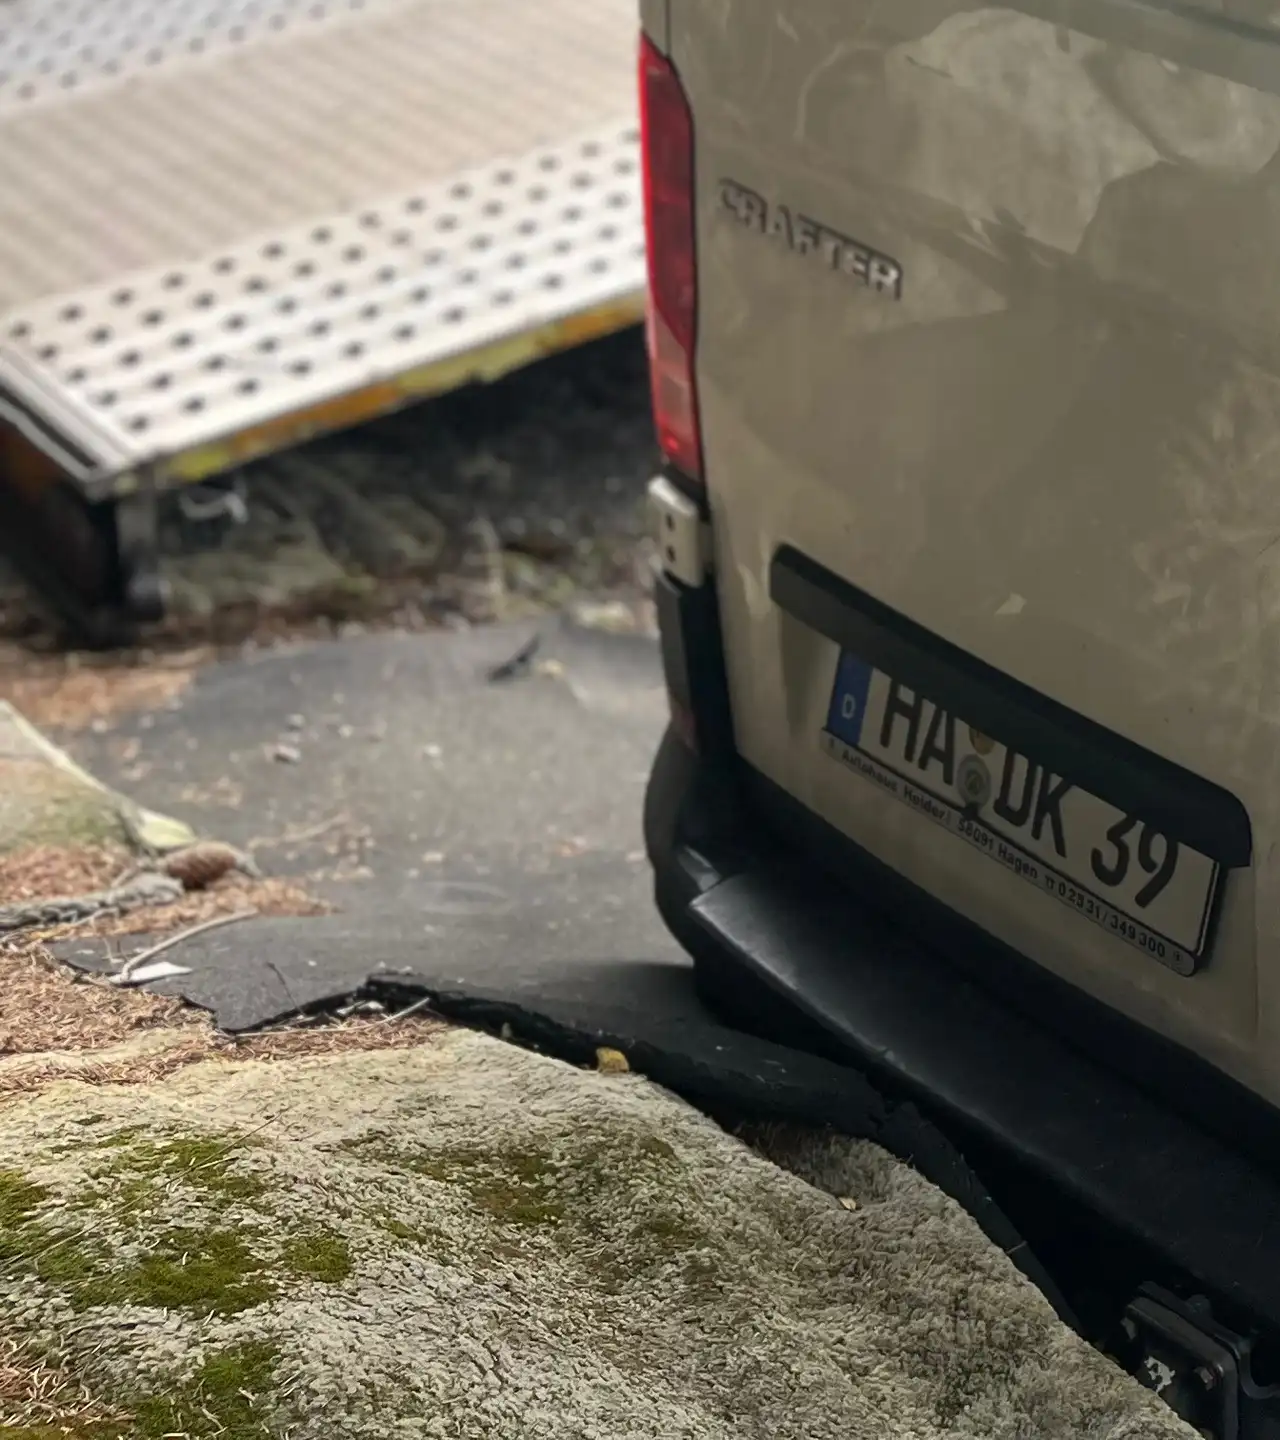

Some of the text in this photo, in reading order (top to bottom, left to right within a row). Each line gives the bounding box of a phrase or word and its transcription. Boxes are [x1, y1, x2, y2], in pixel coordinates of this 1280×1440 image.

[718, 176, 904, 301] CRAFTER
[841, 693, 856, 719] D
[880, 680, 1180, 910] HA DK 39
[997, 842, 1039, 880] Hagen
